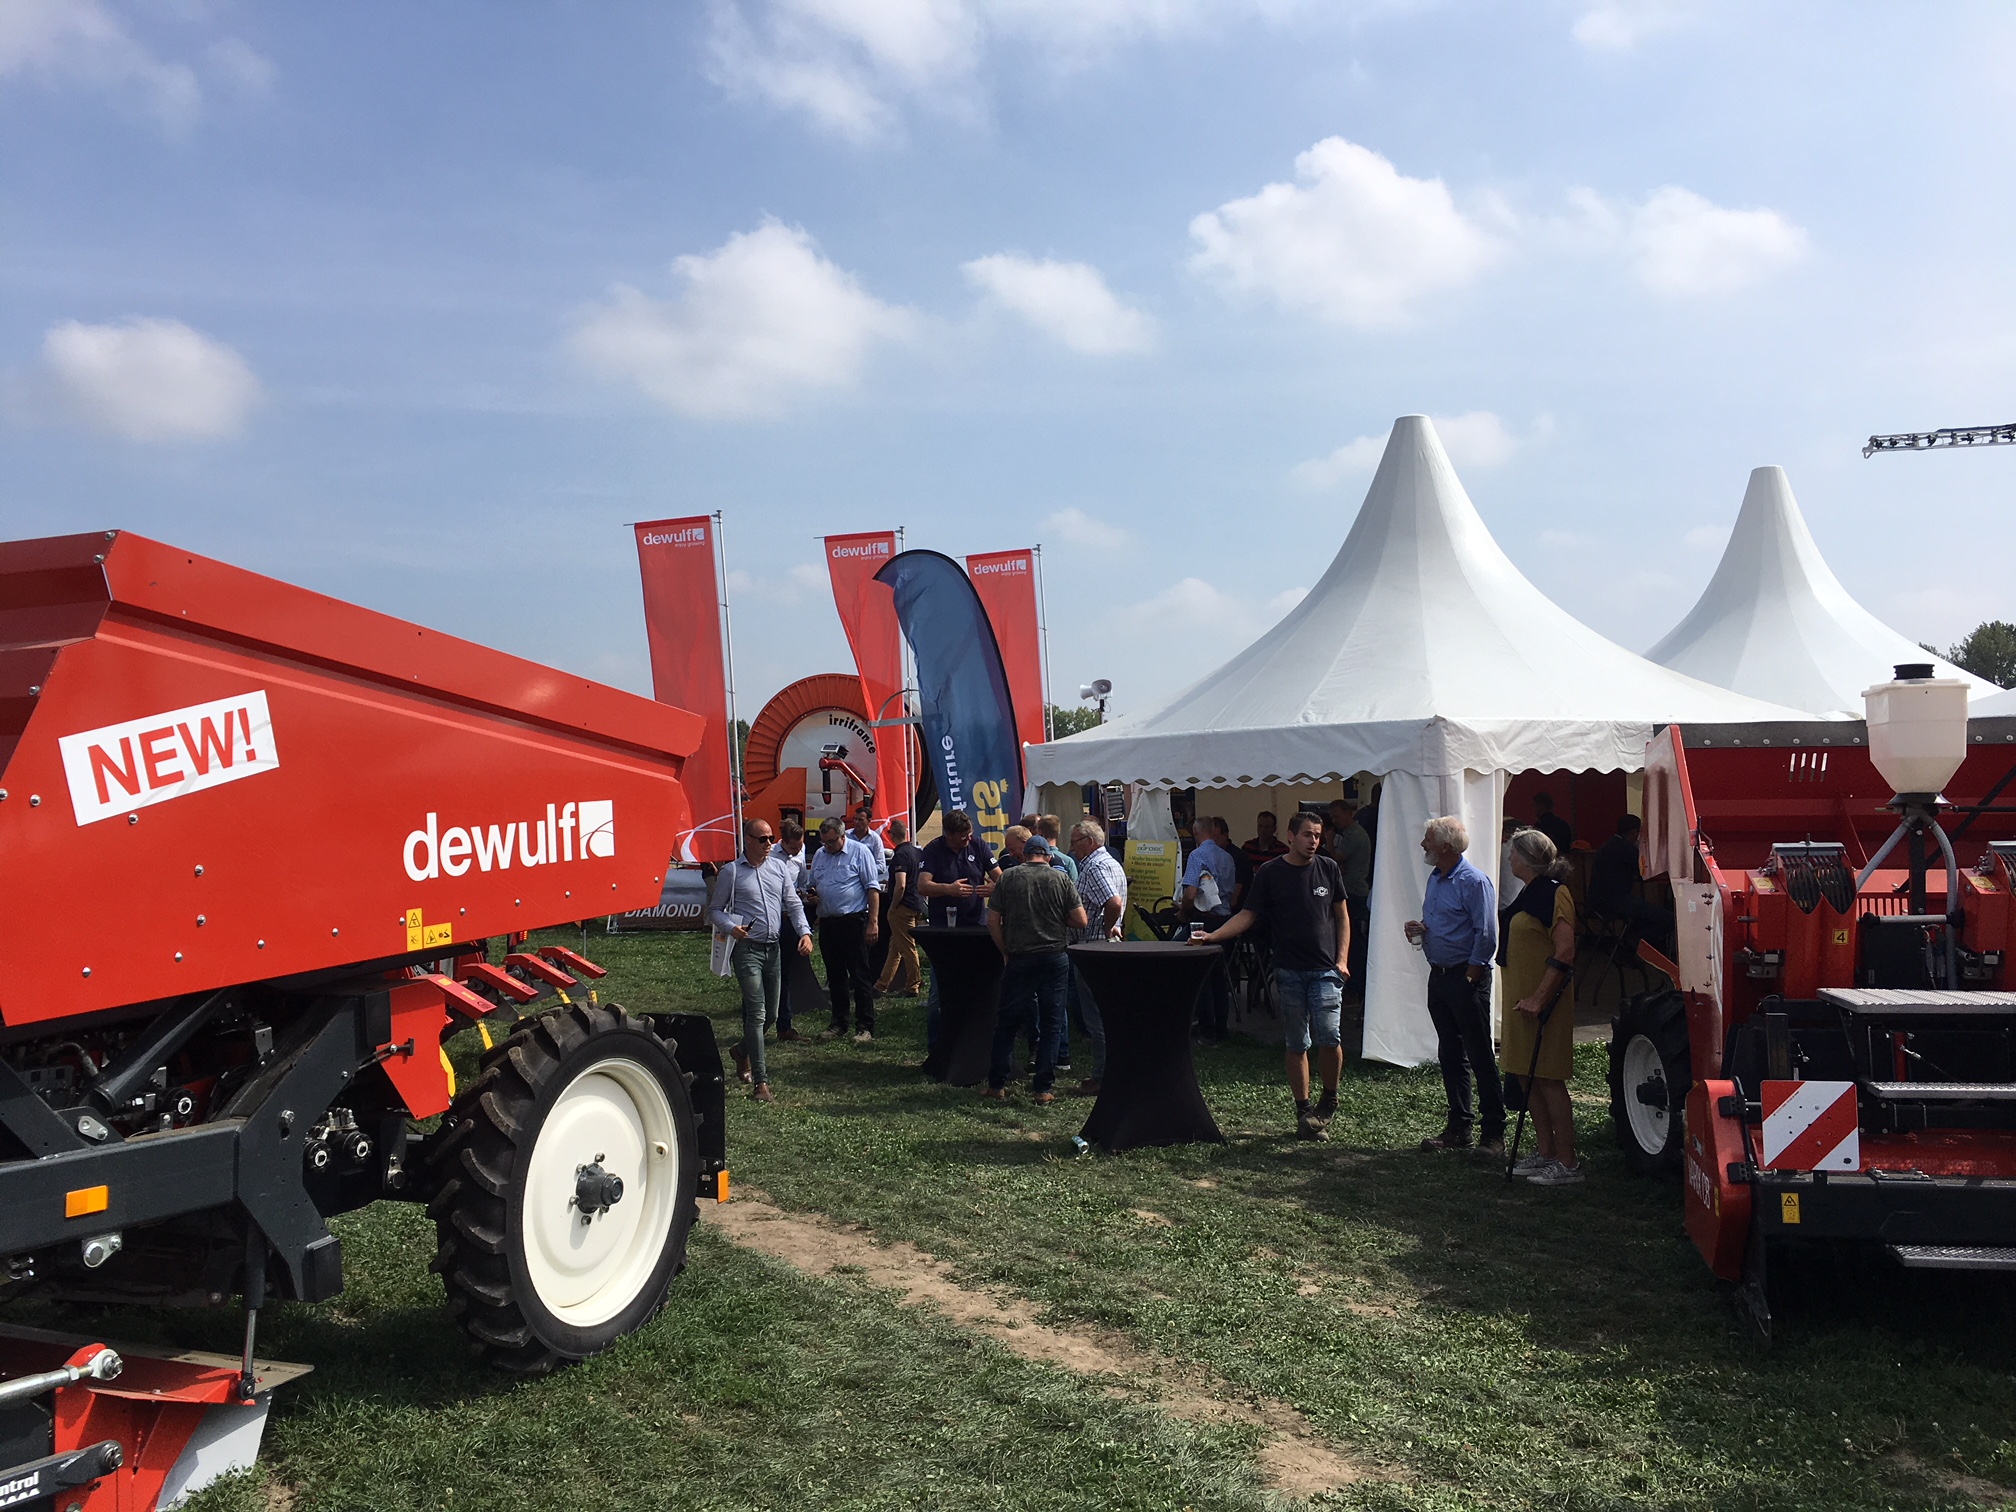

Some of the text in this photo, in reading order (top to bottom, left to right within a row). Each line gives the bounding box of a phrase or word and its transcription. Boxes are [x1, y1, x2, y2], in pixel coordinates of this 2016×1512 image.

[643, 528, 692, 546] dewulf
[832, 543, 877, 558] dewulf
[974, 560, 1016, 575] dewulf
[829, 713, 876, 754] irrifrance
[87, 707, 257, 805] NEW!
[403, 801, 576, 882] dewulf
[1836, 931, 1846, 943] 4
